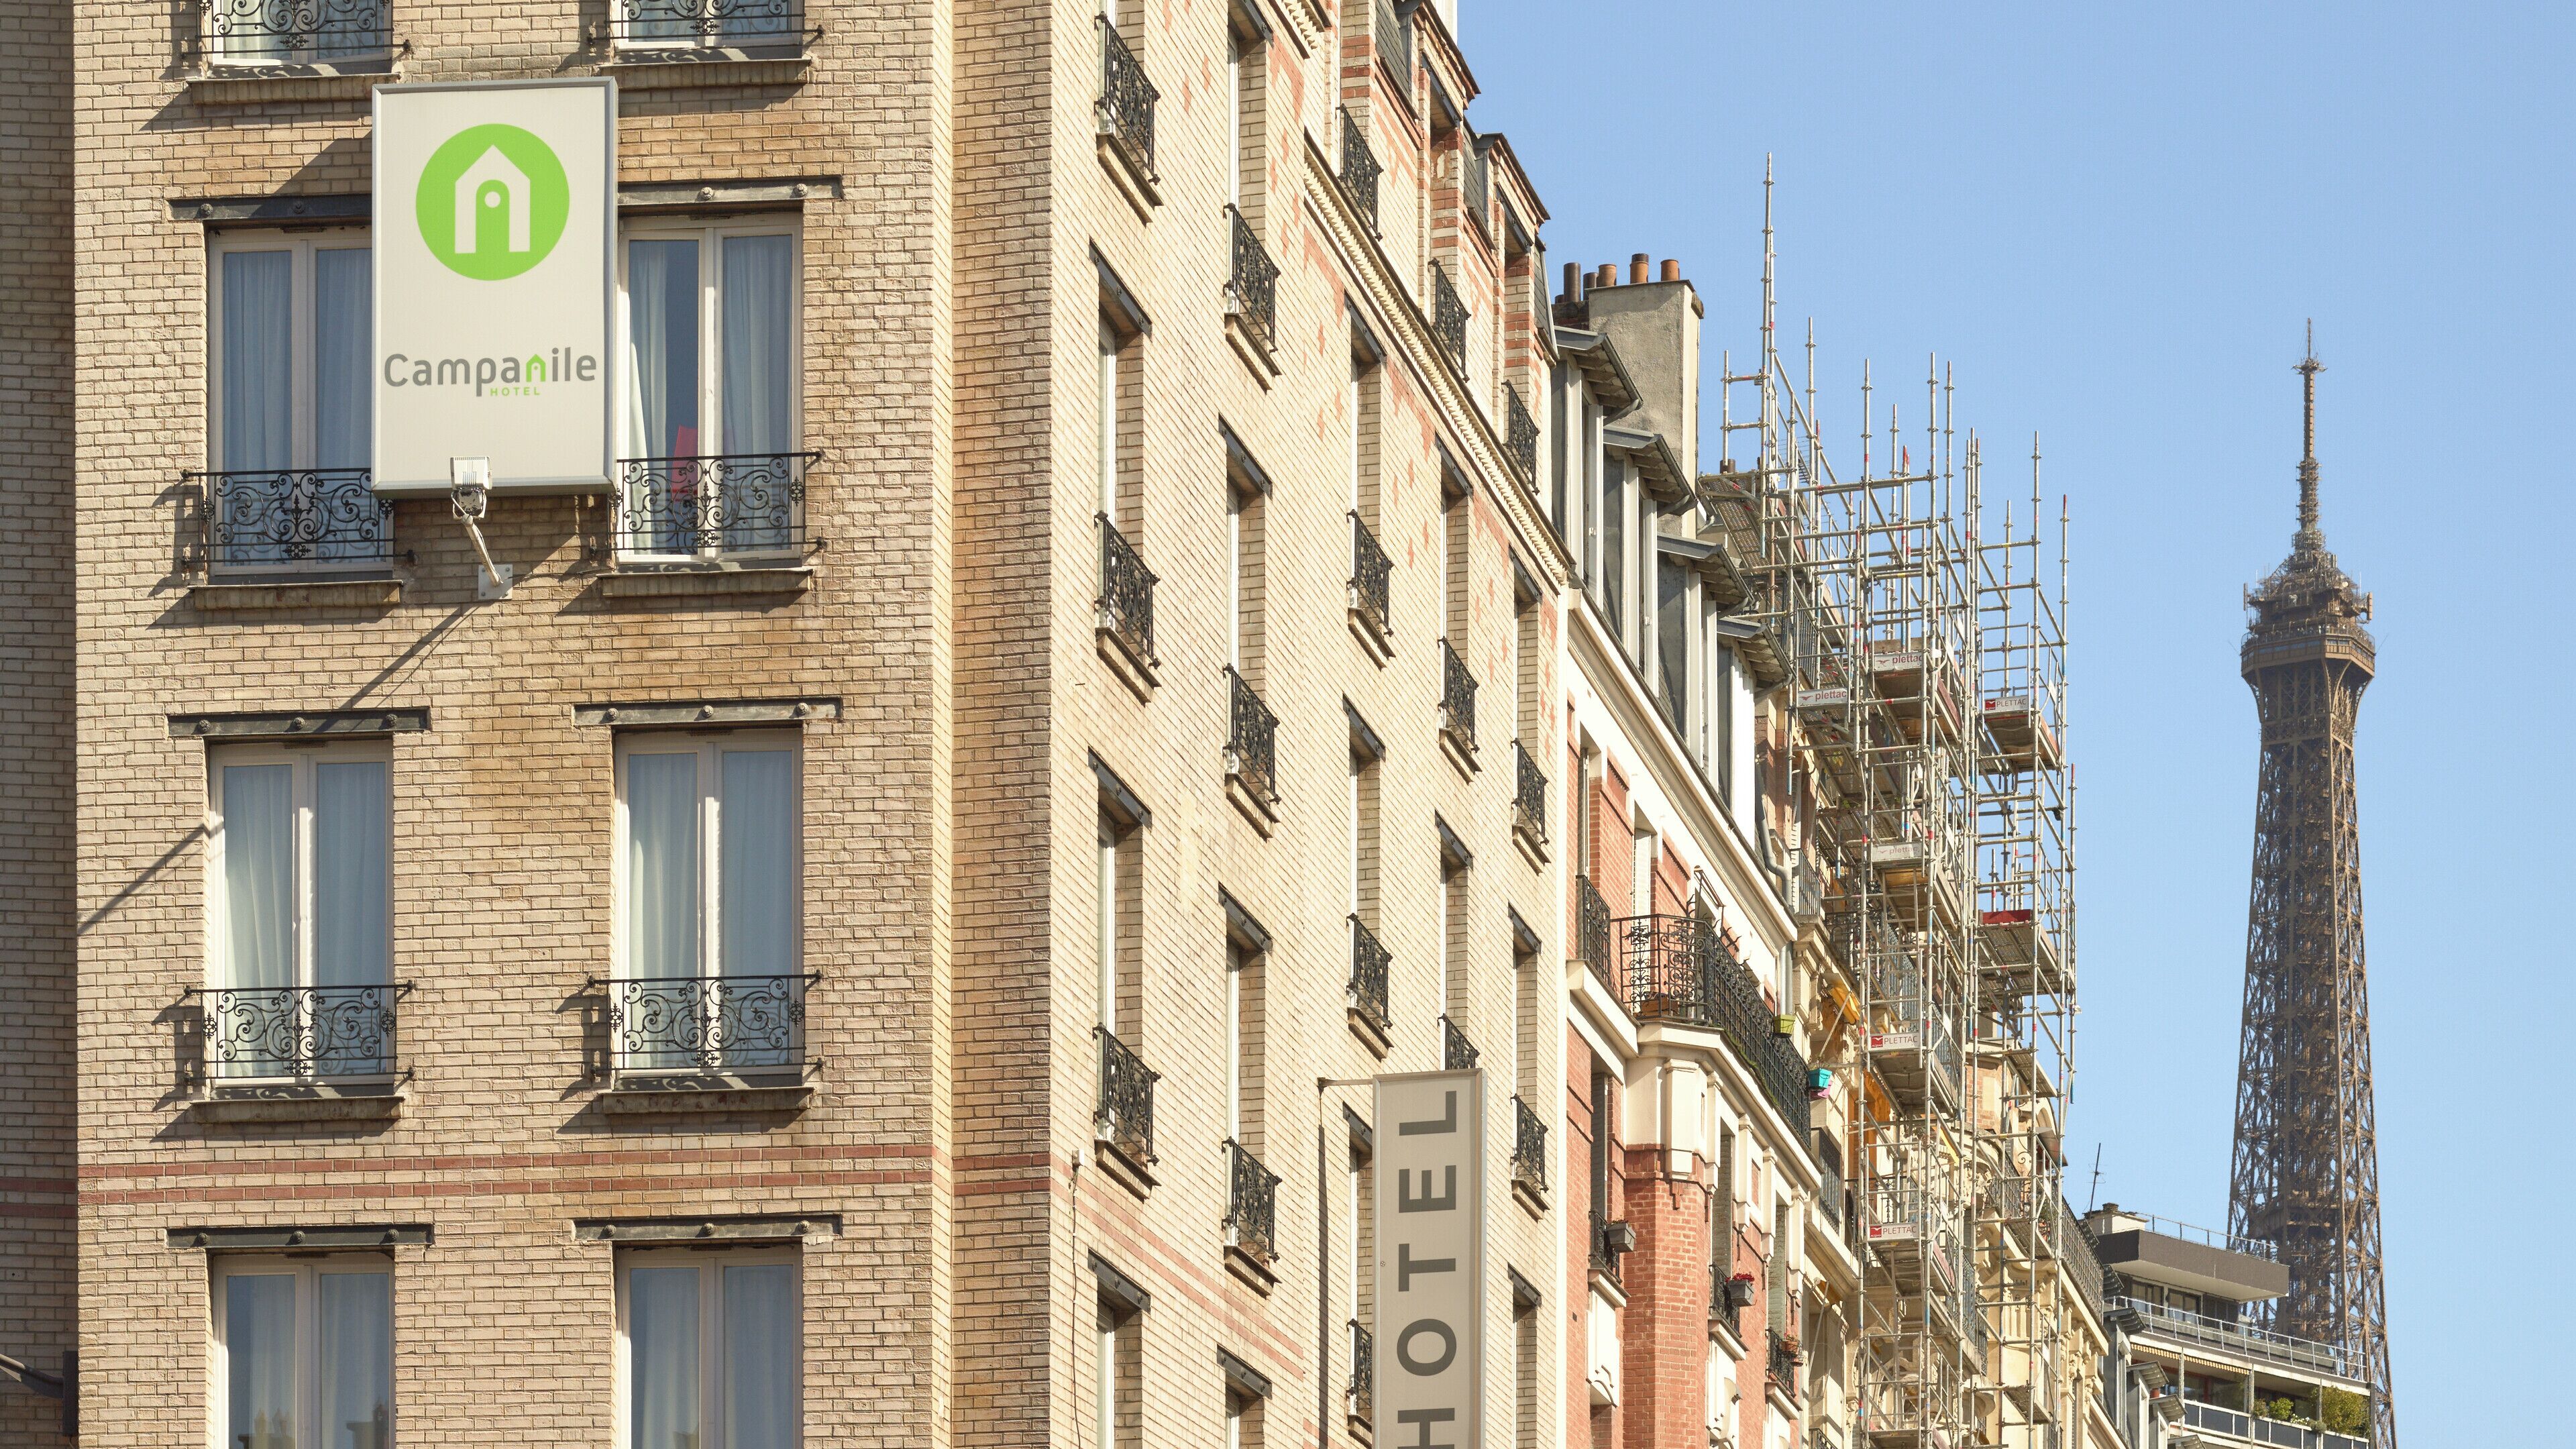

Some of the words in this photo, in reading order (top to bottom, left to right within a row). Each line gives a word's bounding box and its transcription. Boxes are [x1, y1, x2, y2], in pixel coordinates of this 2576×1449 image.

[384, 347, 596, 397] Campanile
[490, 386, 540, 396] HOTEL
[1815, 690, 1847, 702] plettac
[1996, 698, 2026, 707] PLETTAC
[1884, 1036, 1918, 1044] PLETTAC
[1882, 1226, 1917, 1234] PLETTAC
[1397, 1091, 1457, 1449] HOTEL
